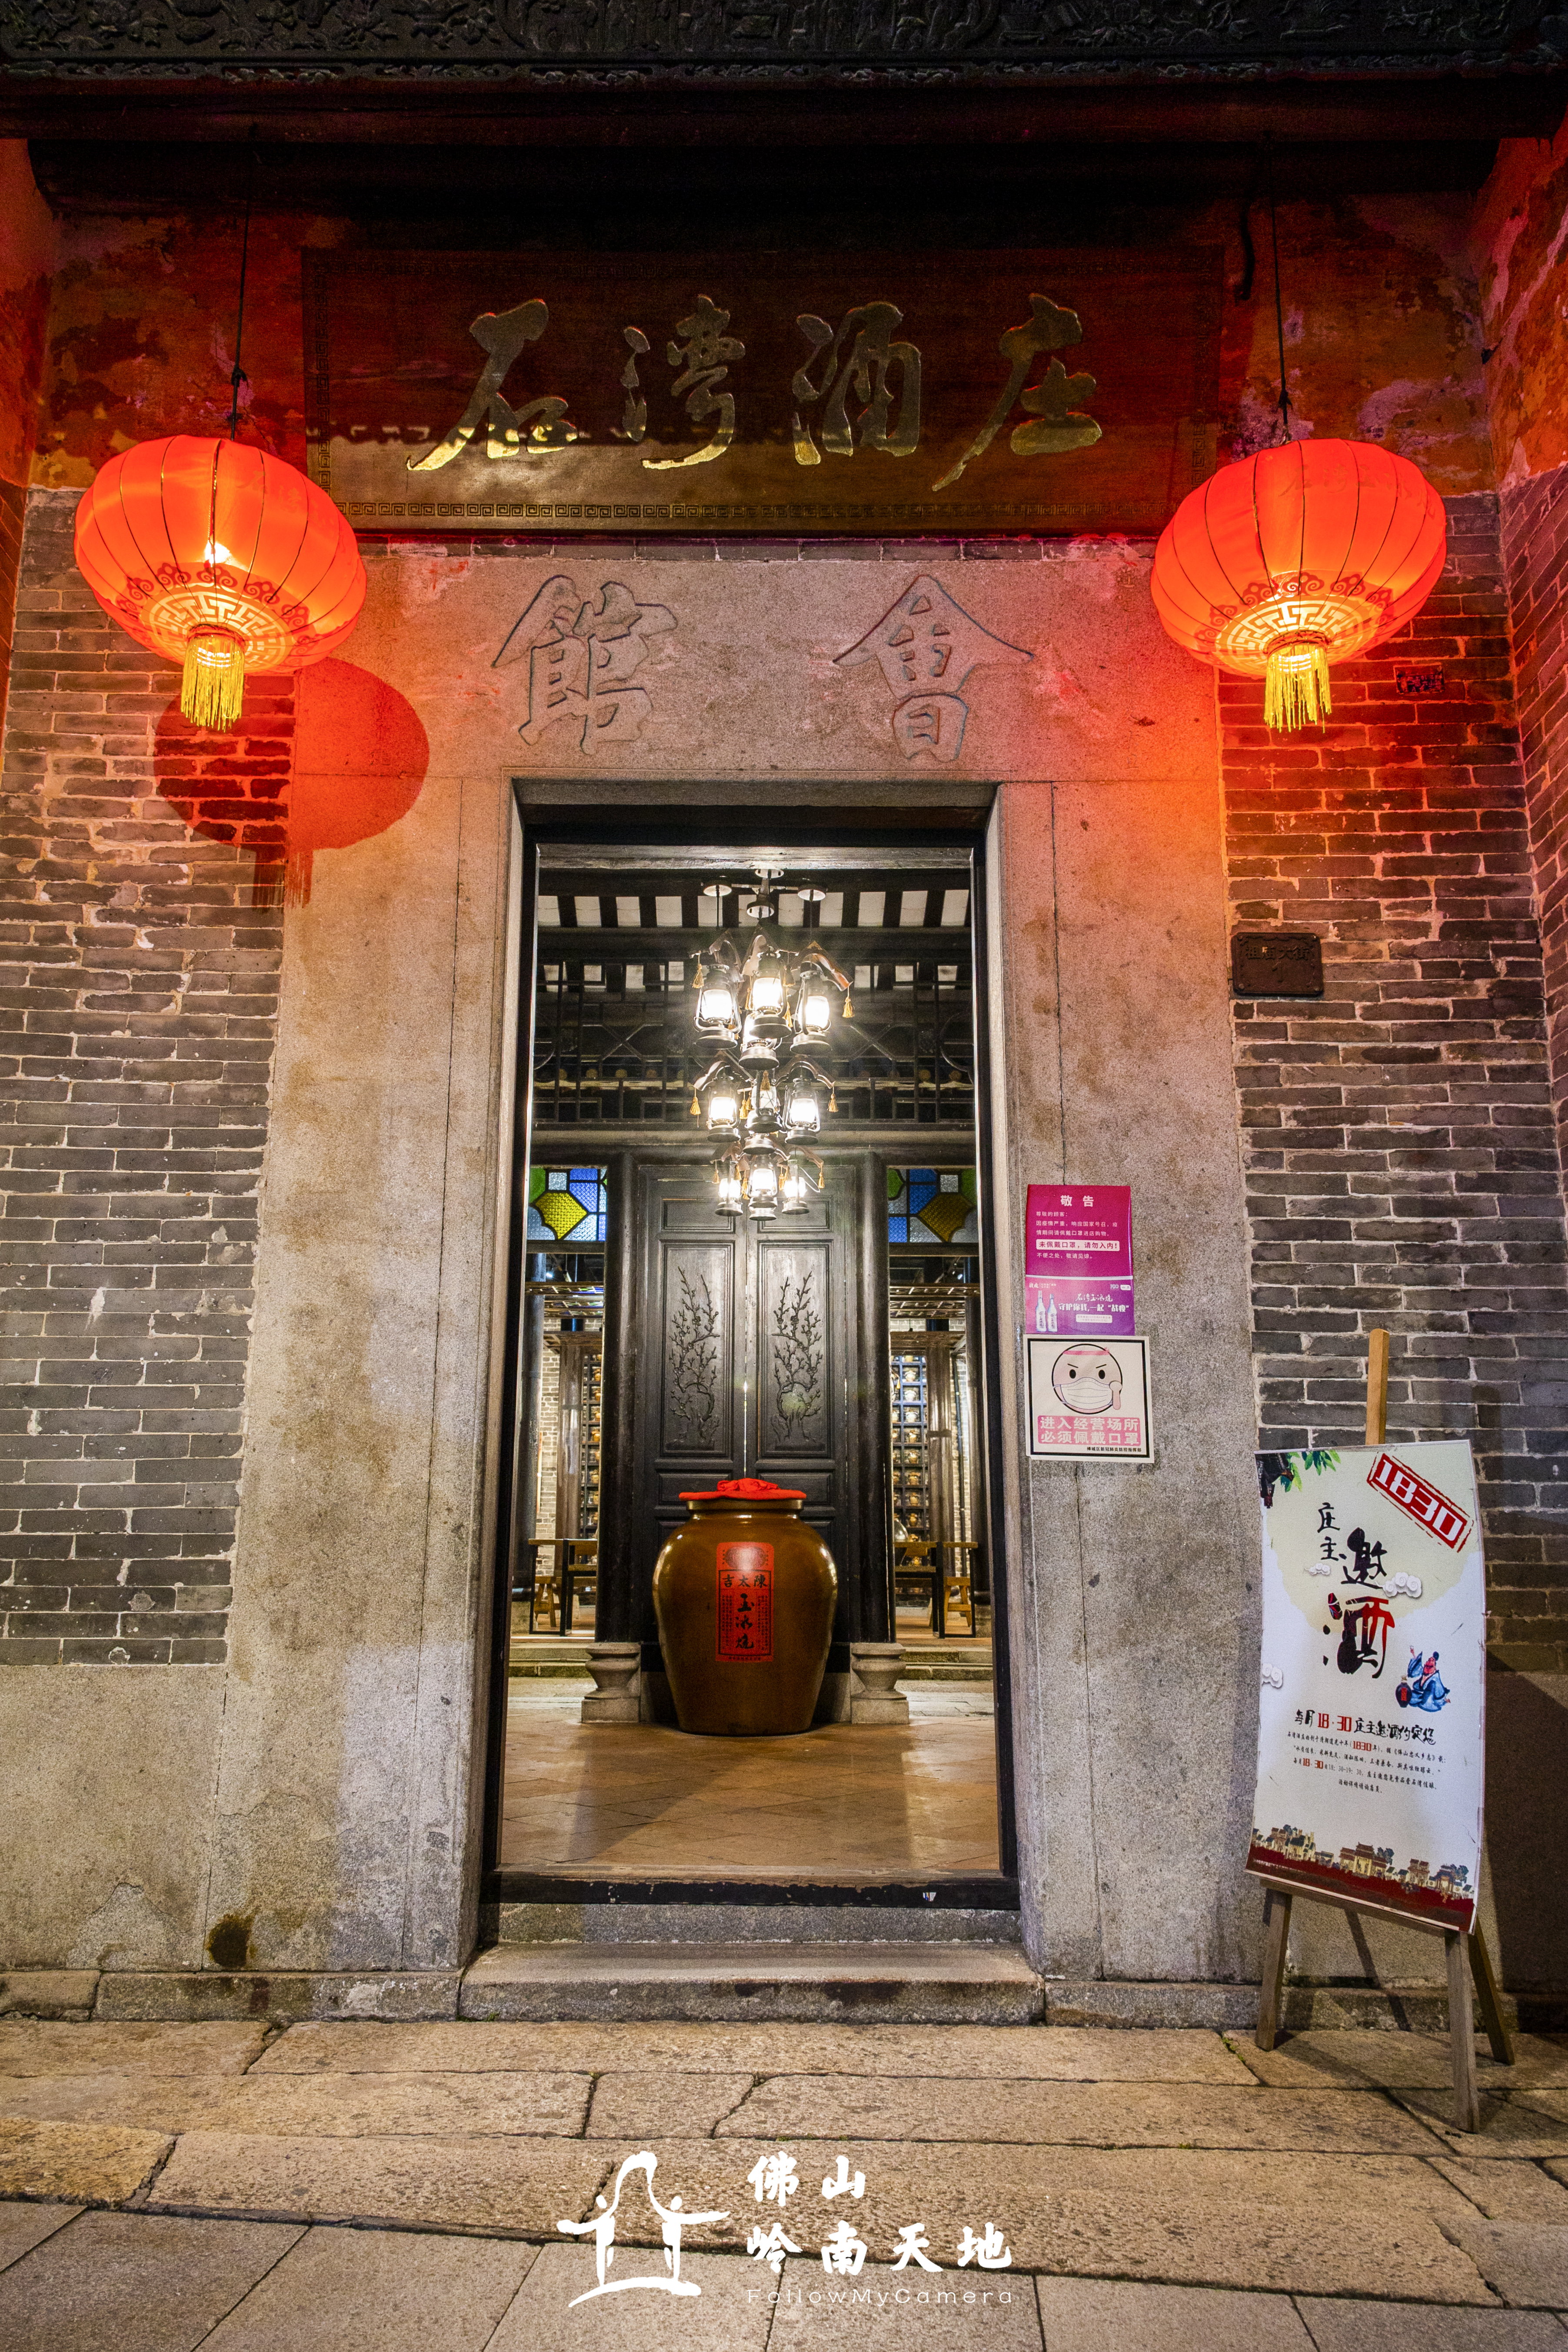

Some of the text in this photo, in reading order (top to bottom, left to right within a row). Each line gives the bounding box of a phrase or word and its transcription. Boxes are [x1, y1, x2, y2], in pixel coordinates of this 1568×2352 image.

[1060, 1195, 1094, 1207] 敬告
[1040, 1416, 1139, 1431] 进入经营场所
[1041, 1430, 1139, 1445] 必须佩戴口罩
[1375, 1459, 1464, 1542] 1830
[1317, 1502, 1340, 1562] 庄主
